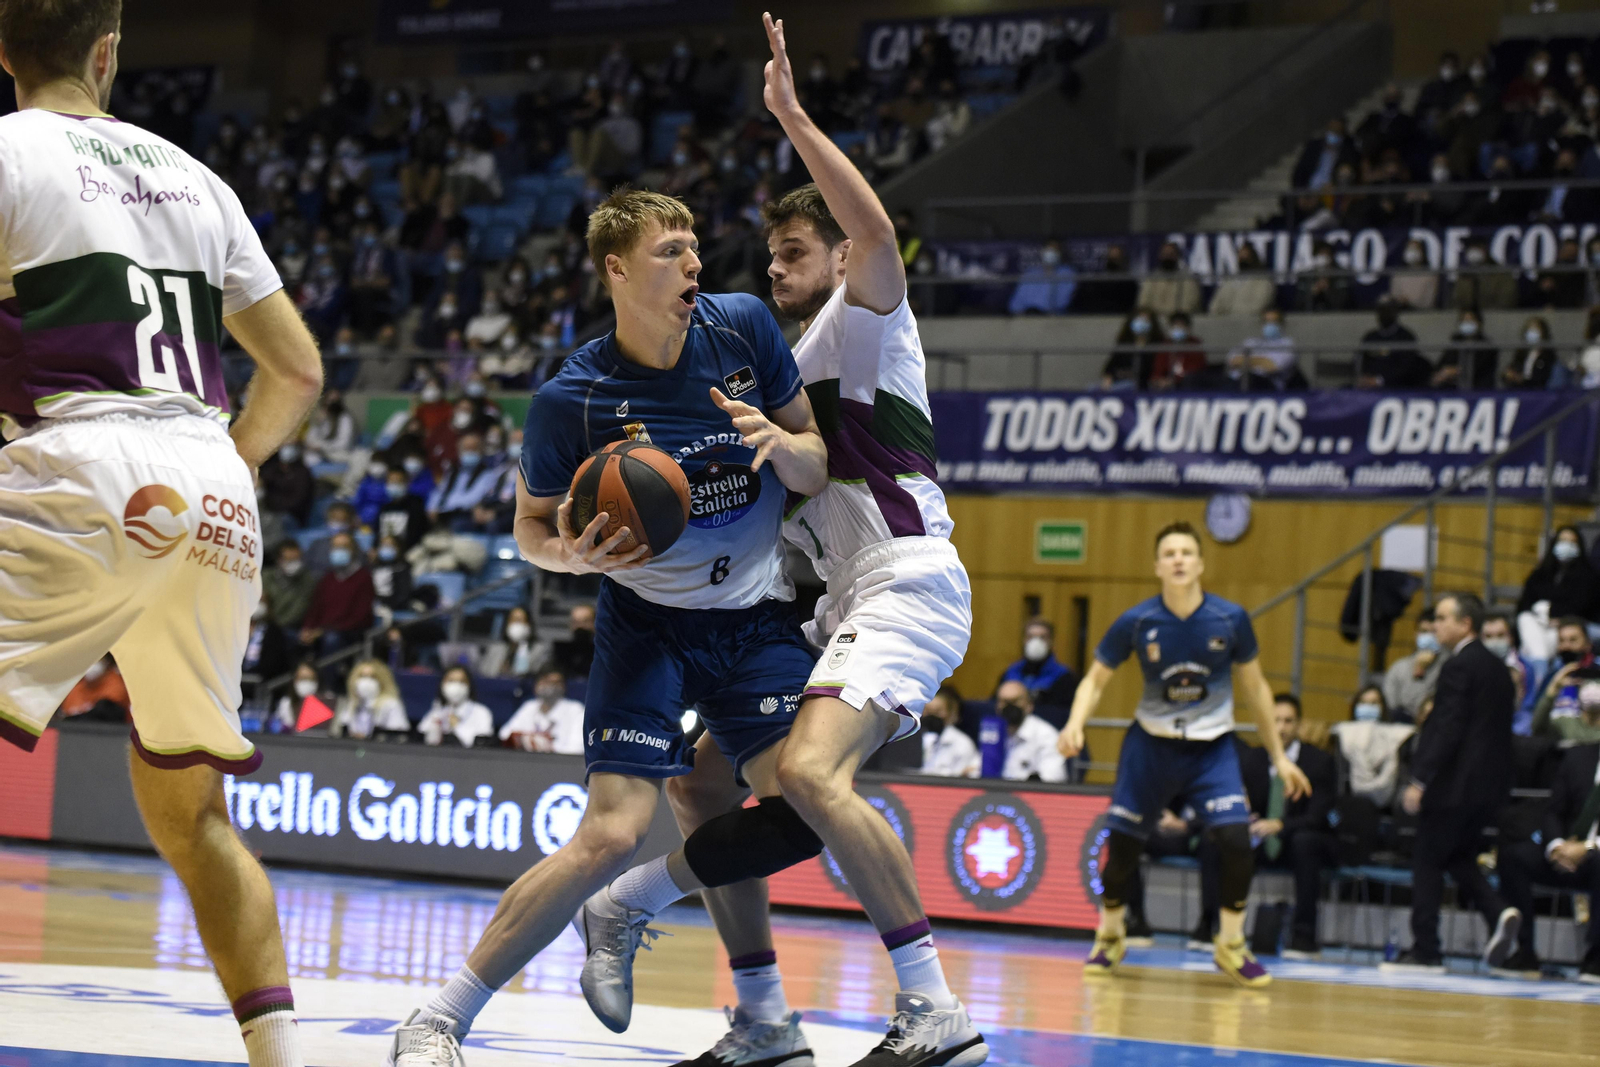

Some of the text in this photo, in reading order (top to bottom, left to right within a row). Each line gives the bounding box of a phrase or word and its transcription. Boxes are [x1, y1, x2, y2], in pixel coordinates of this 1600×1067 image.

[126, 264, 205, 400] 21
[982, 397, 1521, 454] TODOS XUNTOS... OBRA!
[690, 474, 749, 499] Estrella
[690, 491, 748, 515] Galicia
[196, 521, 235, 549] DEL
[185, 546, 258, 583] MÁLAGA
[710, 555, 731, 586] 8
[348, 773, 522, 852] Galicia
